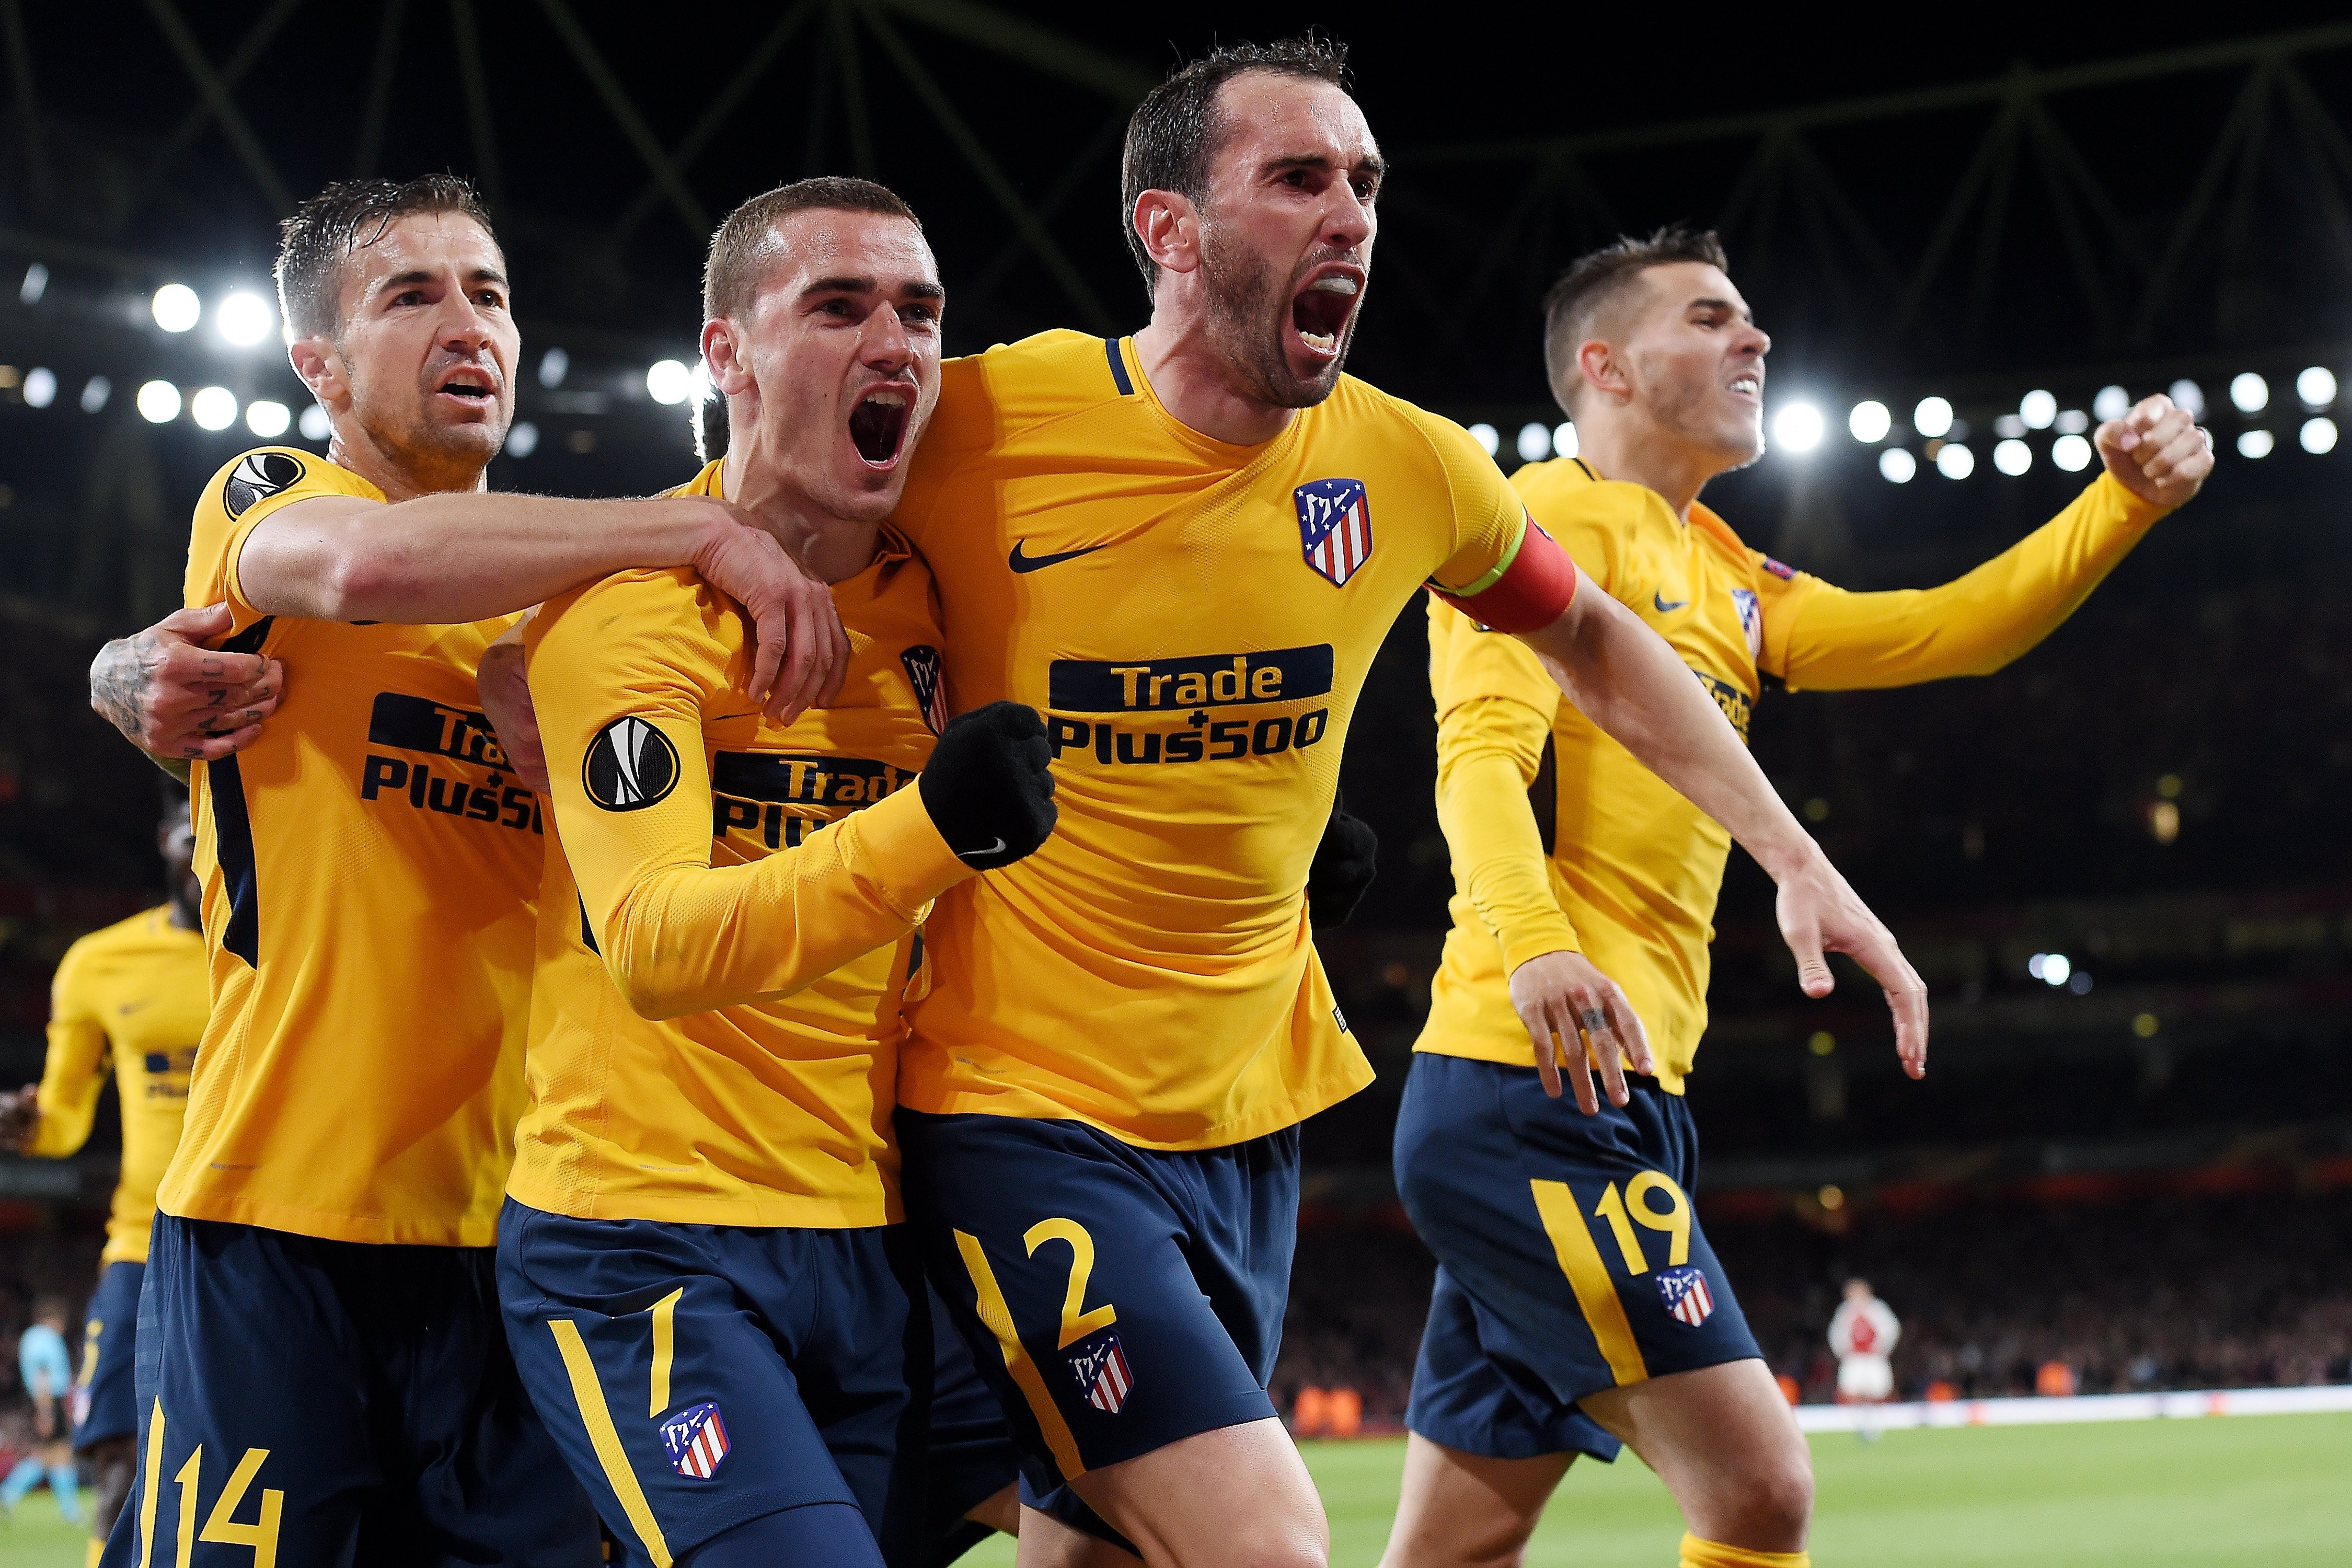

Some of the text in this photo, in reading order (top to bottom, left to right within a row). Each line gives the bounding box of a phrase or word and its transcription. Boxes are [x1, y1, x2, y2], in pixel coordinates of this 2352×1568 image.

[1110, 656, 1283, 707] Trade
[1046, 708, 1329, 765] Plus500
[1594, 1170, 1691, 1276] 19
[1023, 1217, 1117, 1351] 2
[174, 1443, 284, 1568] 14
